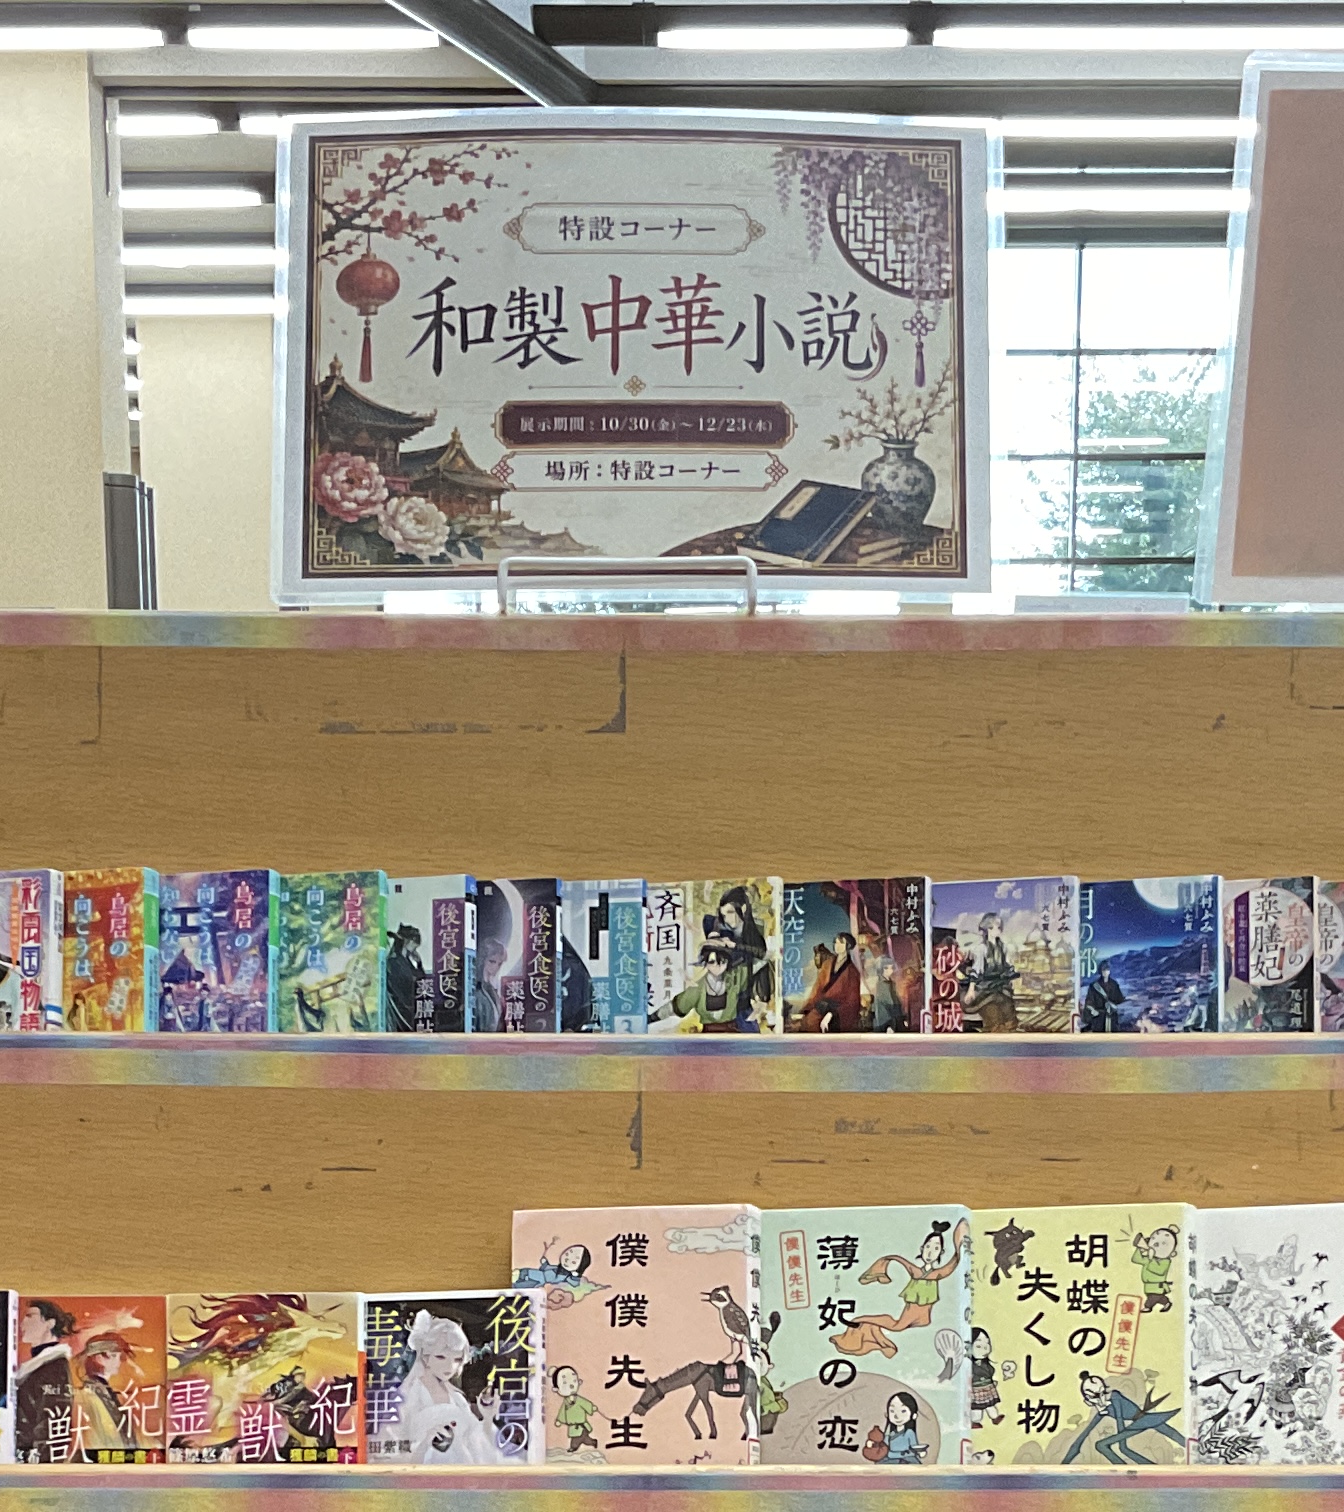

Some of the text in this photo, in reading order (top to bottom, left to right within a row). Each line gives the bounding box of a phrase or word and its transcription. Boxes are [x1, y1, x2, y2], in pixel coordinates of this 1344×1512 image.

[558, 215, 719, 242] 特設コーナー
[406, 273, 875, 378] 和製中華小説
[109, 892, 130, 957] 鳥居の
[234, 881, 255, 948] 鳥居の
[344, 883, 365, 949] 鳥居の
[783, 886, 805, 995] 天空の翼
[905, 883, 919, 934] 中村ふみ
[1057, 884, 1071, 933] 中村ふみ
[1199, 884, 1214, 933] 中村ふみ
[1251, 891, 1283, 981] 薬膳妃
[1286, 903, 1309, 967] 皇帝の
[438, 902, 461, 1009] 後宮食医の
[528, 905, 552, 1012] 後宮食医の
[614, 906, 638, 1012] 後宮食医の
[935, 946, 963, 1033] 砂の城
[784, 1237, 806, 1303] 僕僕先生
[1066, 1234, 1110, 1356] 胡蝶の
[366, 1306, 403, 1434] 毒華
[485, 1295, 536, 1454] 後宮の
[605, 1232, 650, 1450] 僕僕先生
[817, 1235, 860, 1452] 薄妃の恋
[1017, 1266, 1060, 1434] 失くし物
[1111, 1300, 1136, 1369] 僕僕先生
